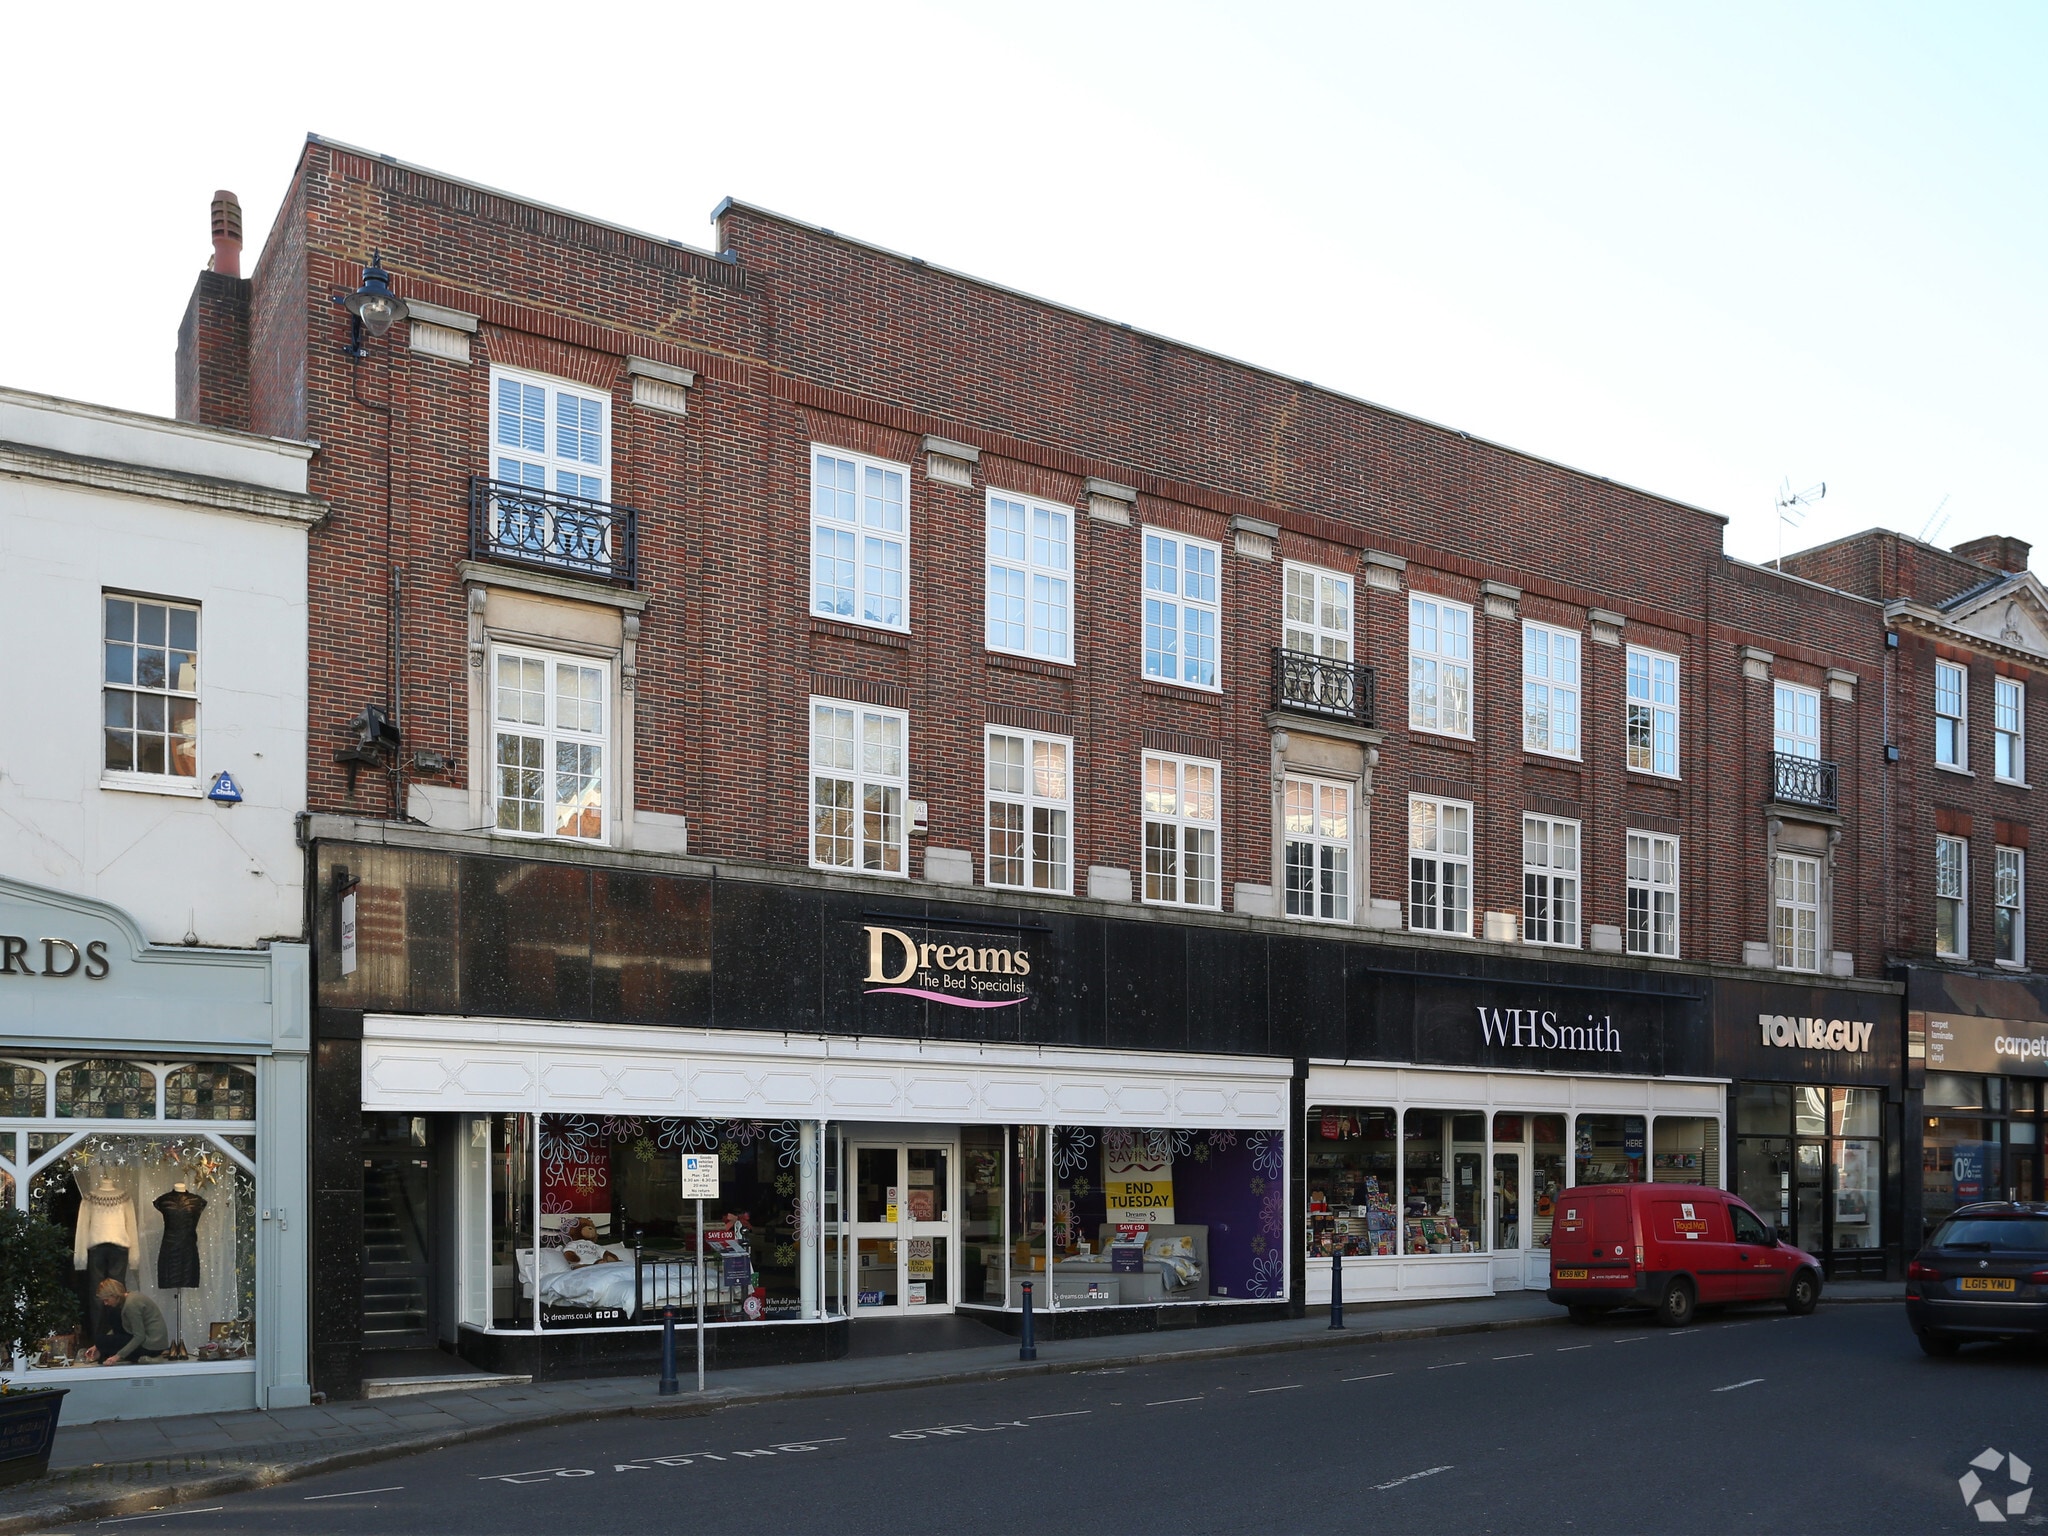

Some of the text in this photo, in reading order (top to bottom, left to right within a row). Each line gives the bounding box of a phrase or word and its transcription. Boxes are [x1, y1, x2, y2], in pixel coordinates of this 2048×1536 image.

[0, 935, 110, 980] RDS
[864, 926, 1030, 984] Dreams
[918, 972, 1025, 994] The Bed Specialist
[1476, 1006, 1622, 1053] WHSmith
[1931, 1021, 1948, 1030] carpet
[1758, 1014, 1874, 1052] TONI&GUY
[1931, 1031, 1954, 1040] laminate
[1931, 1043, 1944, 1052] rugs
[1931, 1054, 1944, 1063] vinyl
[1625, 1139, 1644, 1148] HERE
[1954, 1158, 1972, 1181] 0%
[545, 1168, 606, 1187] SAVERS
[1125, 1183, 1153, 1194] END
[1110, 1196, 1169, 1208] TUESDAY
[1676, 1221, 1705, 1231] Royal Mail
[1965, 1278, 2011, 1290] LG15 YMU
[551, 1312, 593, 1320] dreams.co.uk
[500, 1420, 1030, 1485] LOADING ONLY
